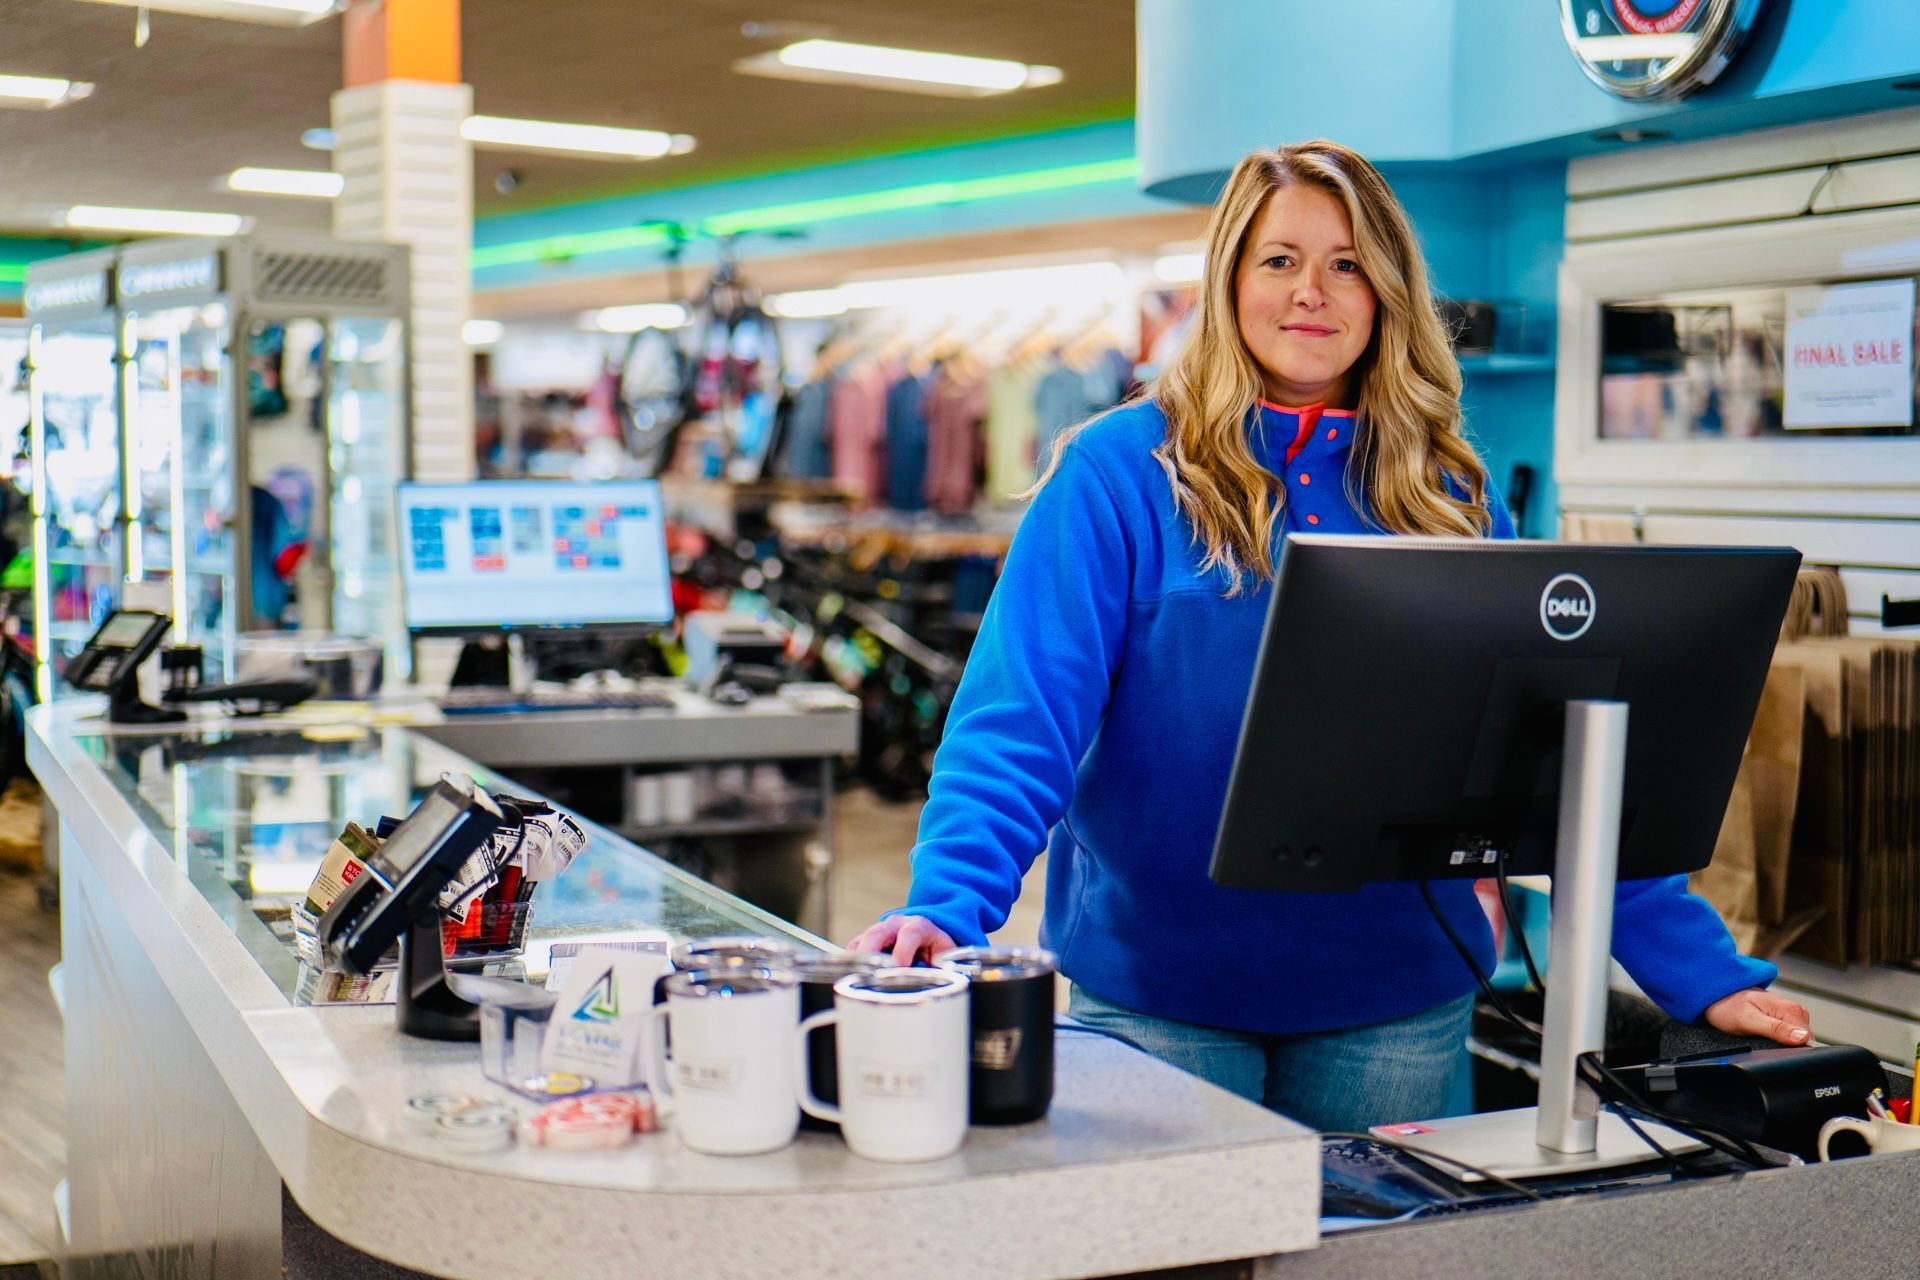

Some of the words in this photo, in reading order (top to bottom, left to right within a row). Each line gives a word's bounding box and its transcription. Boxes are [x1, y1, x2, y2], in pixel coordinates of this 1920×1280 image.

[1794, 342, 1848, 369] FINAL
[1853, 337, 1902, 366] SALE
[1547, 597, 1590, 618] DELL
[1813, 1085, 1841, 1099] EPSON
